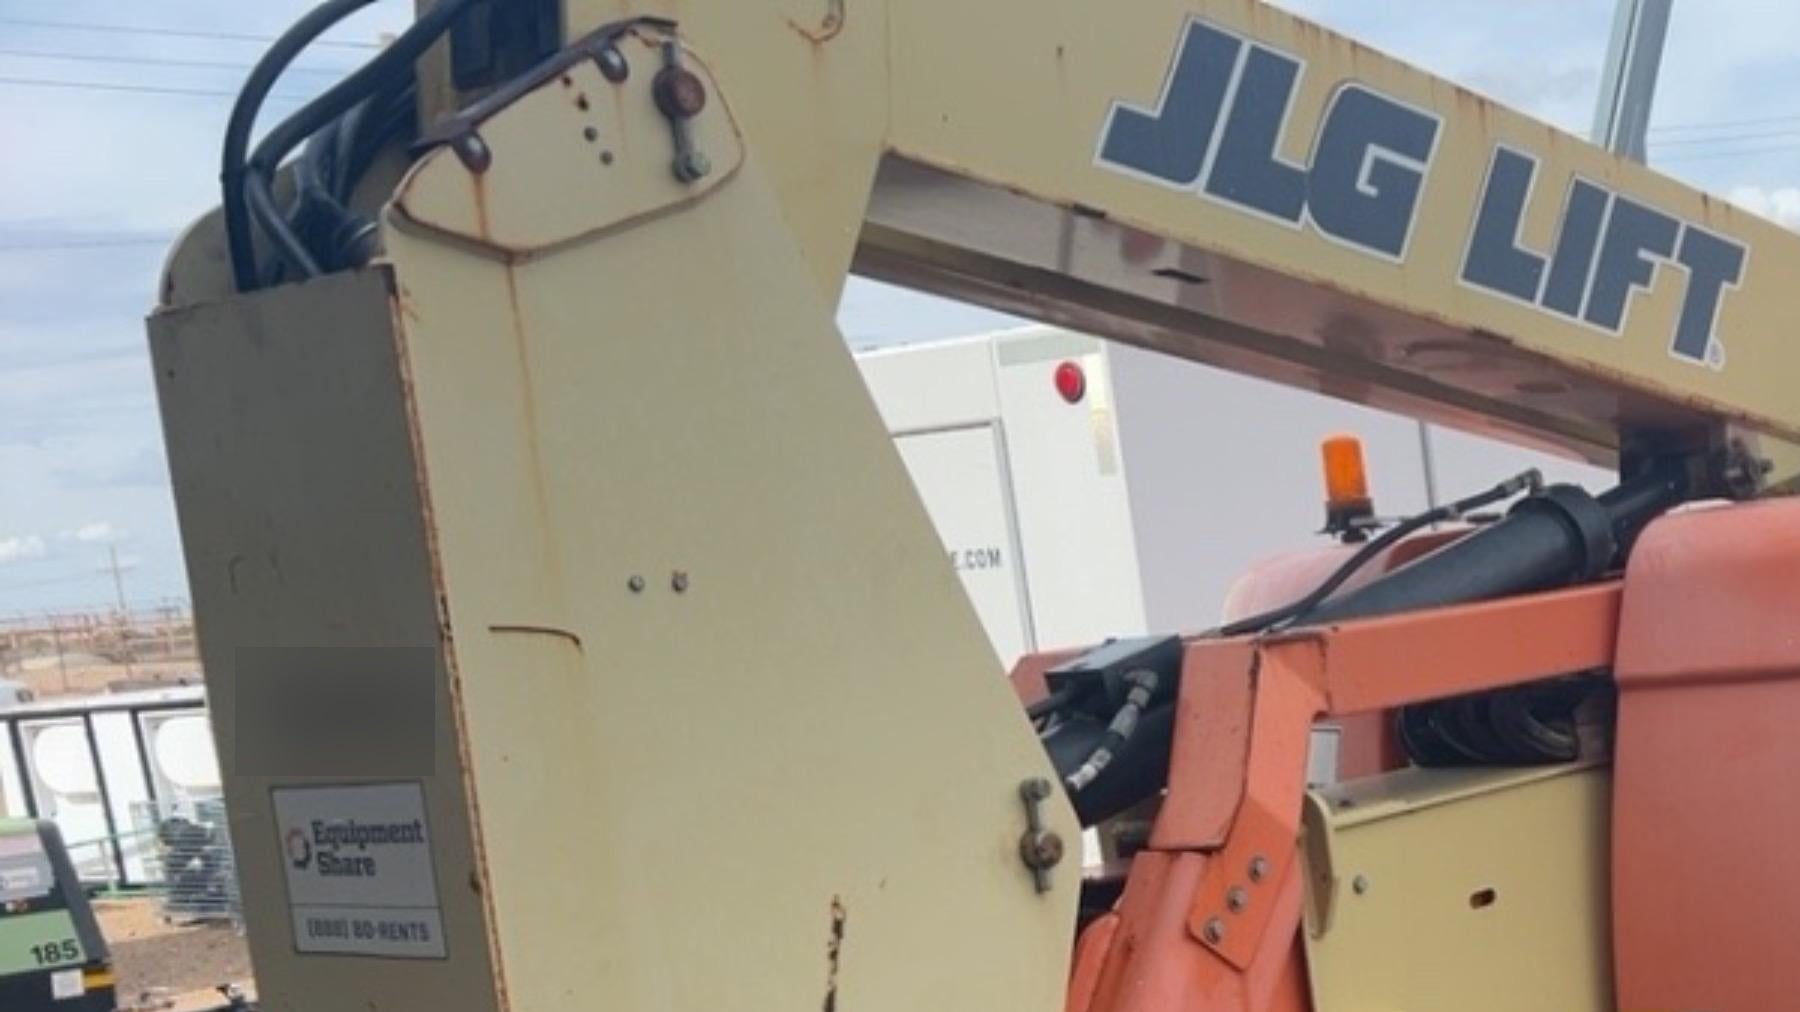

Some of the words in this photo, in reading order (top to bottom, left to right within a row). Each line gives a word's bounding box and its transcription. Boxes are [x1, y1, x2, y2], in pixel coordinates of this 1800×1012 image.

[1096, 16, 1443, 263] JLG
[1459, 143, 1750, 366] LIFT
[311, 819, 424, 851] Equipment
[316, 852, 377, 876] Share
[30, 939, 80, 966] 185
